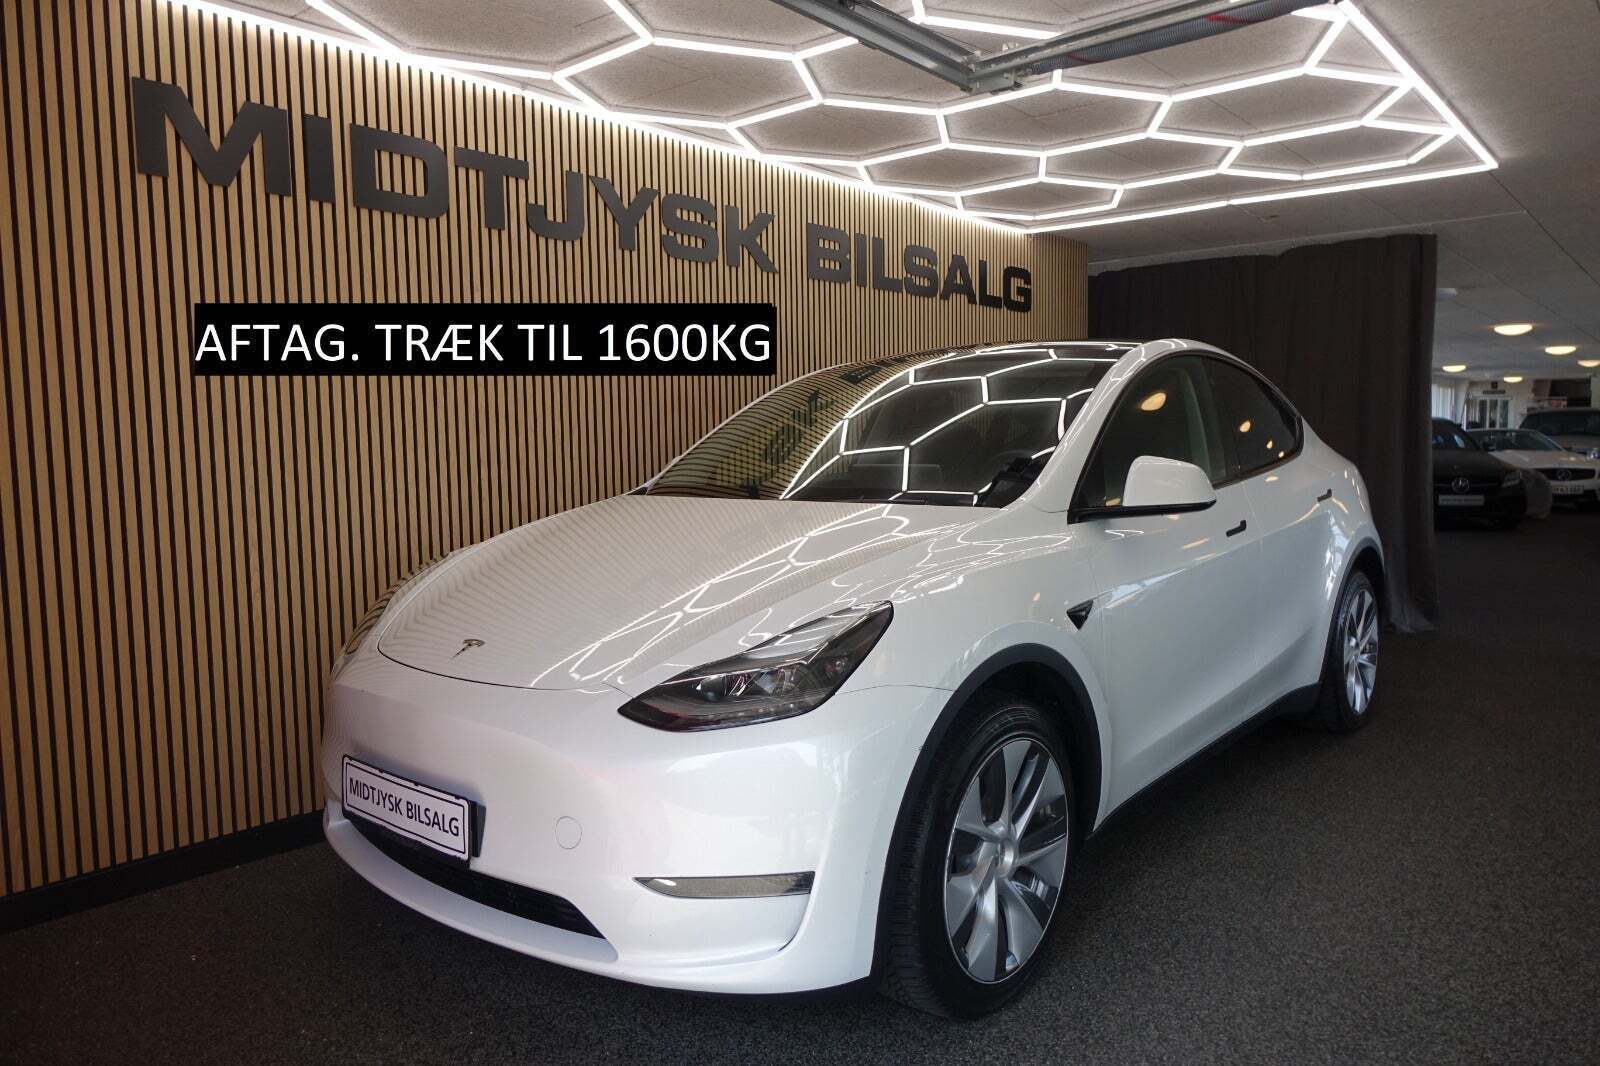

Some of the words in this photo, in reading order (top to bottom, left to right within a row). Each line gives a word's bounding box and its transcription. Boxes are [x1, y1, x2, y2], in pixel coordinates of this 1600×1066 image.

[132, 77, 778, 274] MIDTJYSK
[807, 222, 1032, 313] BILSALG
[349, 777, 402, 816] MIDTJYSK
[406, 801, 460, 837] BILSALG
